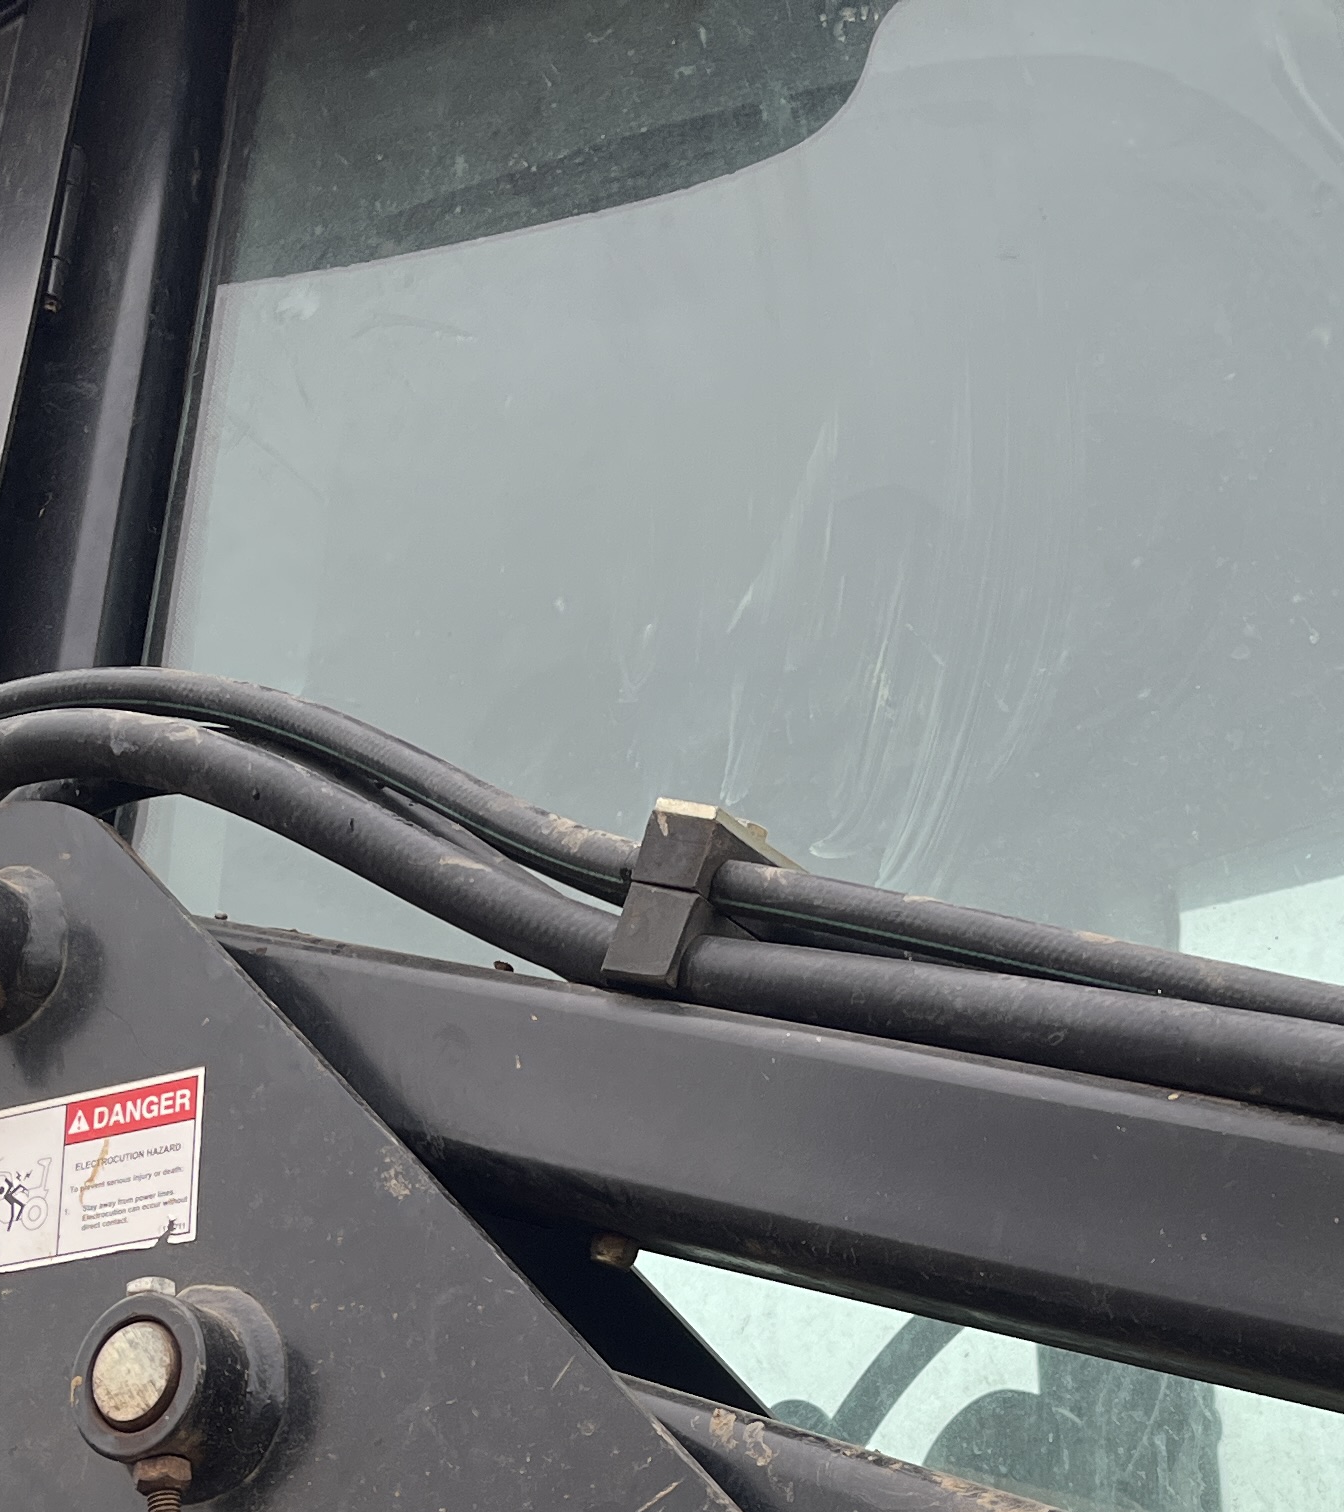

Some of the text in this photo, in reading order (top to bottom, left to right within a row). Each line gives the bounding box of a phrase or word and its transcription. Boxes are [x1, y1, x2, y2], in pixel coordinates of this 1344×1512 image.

[93, 1089, 191, 1130] DANGER
[75, 1143, 182, 1171] ELECTROCUTION HAZARD
